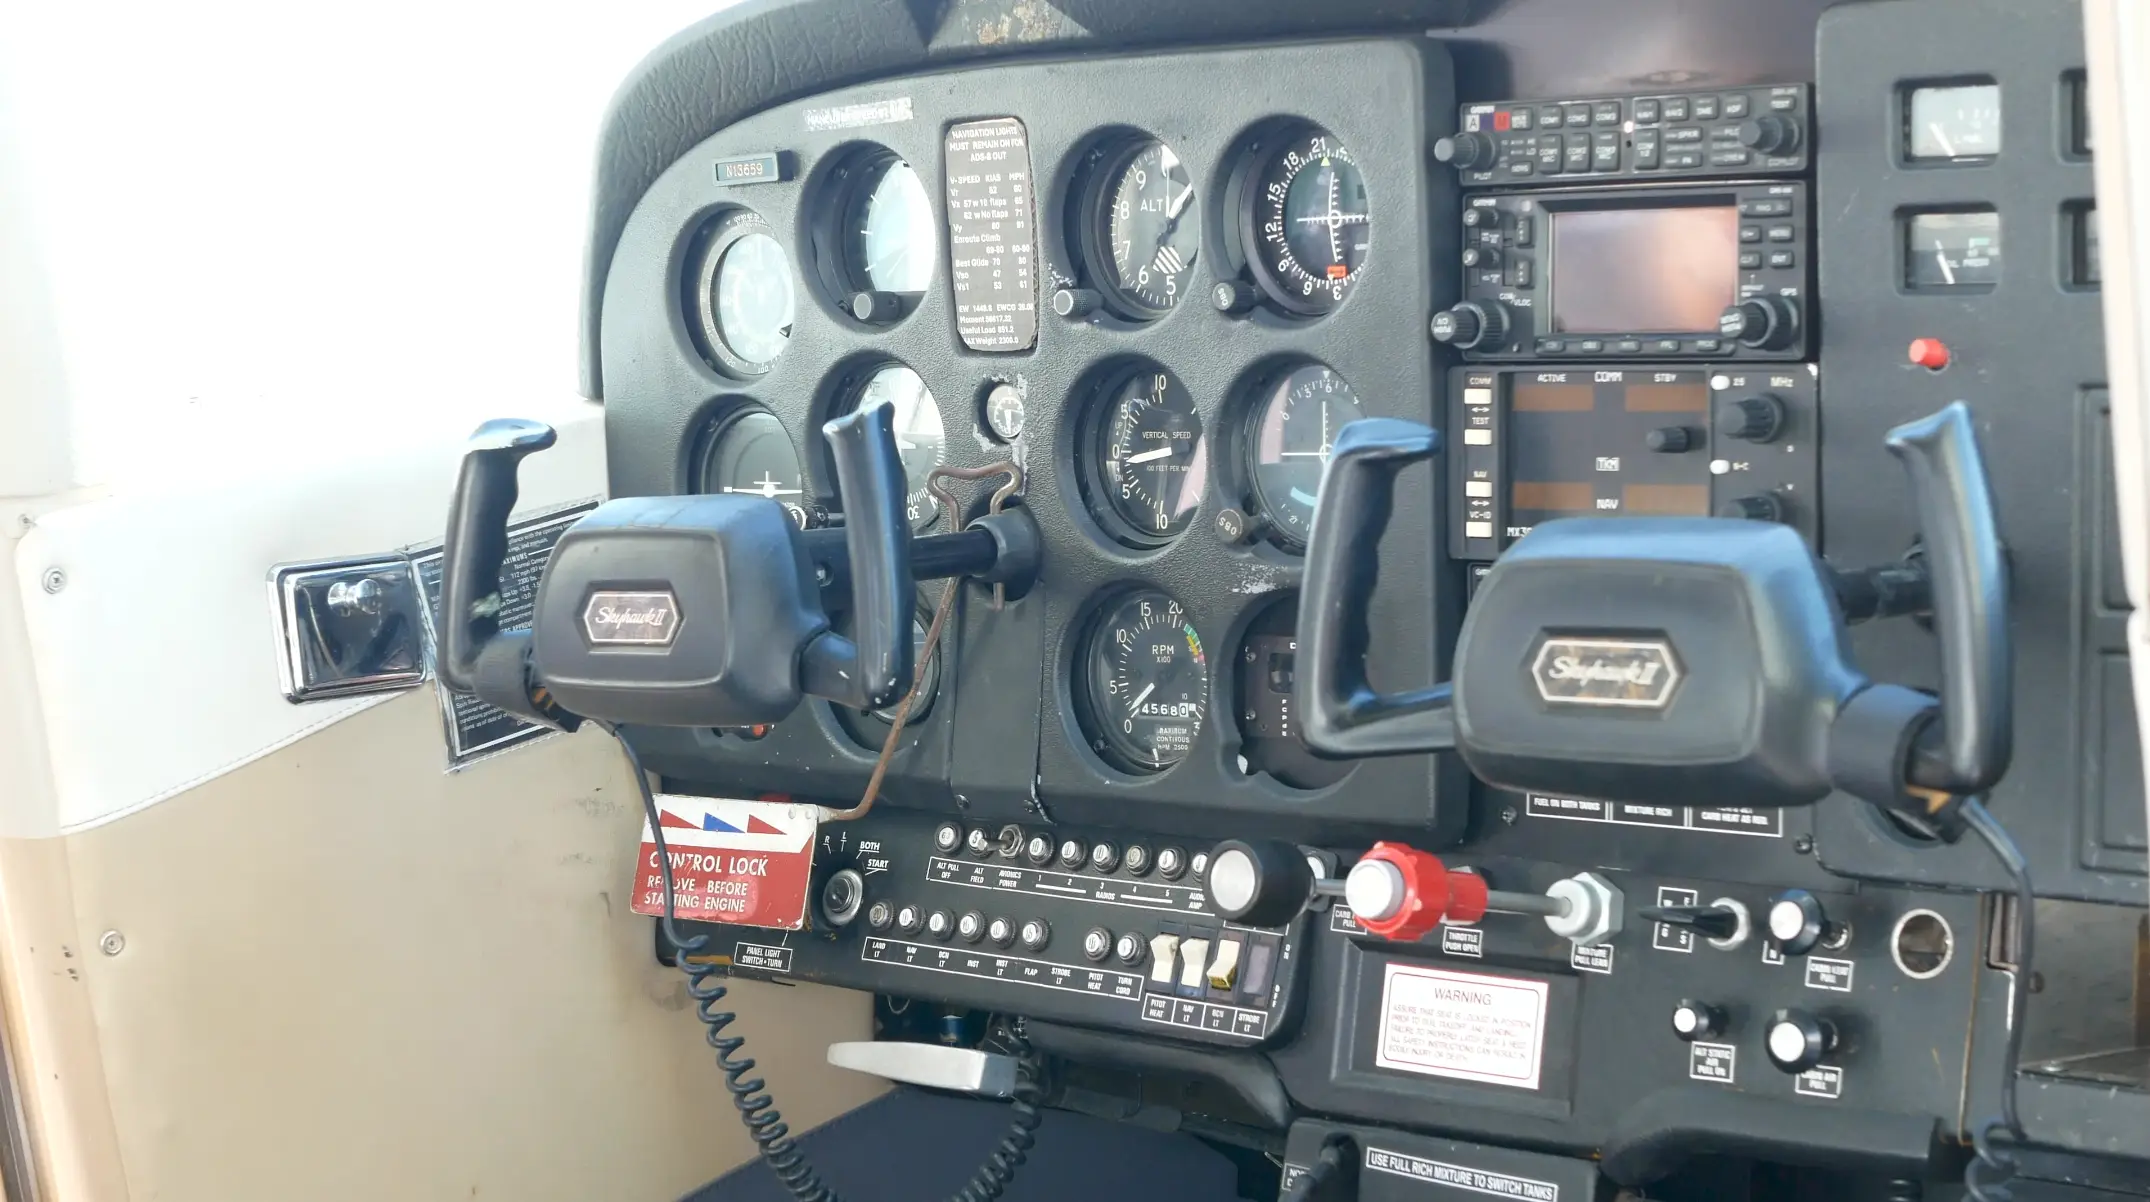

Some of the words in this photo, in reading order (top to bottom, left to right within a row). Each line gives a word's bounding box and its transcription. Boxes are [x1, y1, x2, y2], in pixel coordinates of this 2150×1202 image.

[952, 127, 995, 139] NAVIGATION
[949, 142, 969, 151] MUST
[973, 139, 999, 150] REMAIN
[1000, 139, 1010, 148] ON
[1311, 137, 1326, 153] 21
[993, 151, 1007, 160] OUT
[1283, 152, 1300, 170] 18
[726, 163, 763, 177] N13659
[985, 174, 1001, 182] KIAS
[1009, 172, 1024, 181] MPH
[1135, 171, 1147, 190] 9
[1267, 183, 1281, 201] 15
[1120, 202, 1130, 219] 8
[1140, 200, 1163, 212] ALT
[1266, 222, 1279, 241] 12
[954, 235, 980, 243] Enroute
[981, 234, 1001, 242] Climb
[1122, 240, 1131, 260] 7
[971, 258, 989, 267] Glide
[993, 269, 1001, 277] 47
[1138, 265, 1149, 284] 6
[1166, 276, 1176, 295] 5
[1332, 287, 1342, 300] 3
[959, 305, 969, 313] EW
[960, 315, 985, 323] Moment
[960, 326, 980, 334] Useful
[981, 326, 996, 334] Load
[976, 337, 997, 346] Weight
[1155, 375, 1166, 390] 10
[1537, 374, 1567, 383] ACTIVE
[1594, 372, 1622, 383] COMM
[1654, 373, 1677, 383] STBY
[1770, 376, 1794, 387] MHz
[1121, 404, 1129, 419] 5
[1472, 417, 1490, 425] TEST
[1142, 431, 1168, 439] VERTICAL
[1172, 431, 1191, 439] SPEED
[1112, 445, 1120, 459] 0
[1473, 471, 1487, 479] NAV
[1122, 484, 1130, 499] 5
[1597, 499, 1618, 510] NAV
[1156, 514, 1168, 530] 10
[1219, 518, 1237, 535] OBS
[1140, 602, 1151, 617] 15
[1169, 601, 1183, 614] 20
[595, 607, 654, 629] Skyhawk
[1116, 629, 1127, 644] 10
[1152, 645, 1174, 655] RPM
[1109, 680, 1117, 695] 5
[1124, 719, 1132, 733] 0
[860, 841, 880, 851] BOTH
[729, 856, 768, 876] LOCK
[867, 859, 888, 868] START
[937, 862, 947, 870] ALT
[948, 863, 959, 871] PULL
[999, 870, 1021, 879] AVIONICS
[974, 867, 984, 875] ALT
[970, 875, 984, 883] FIELD
[999, 879, 1017, 887] POWER
[1067, 878, 1073, 886] 2
[707, 880, 748, 896] BEFORE
[1096, 890, 1115, 900] RADIOS
[644, 892, 699, 908] STATING
[705, 897, 745, 912] ENGINE
[1188, 901, 1203, 910] AMP
[1335, 910, 1350, 920] CARB
[1448, 932, 1478, 943] THROTTLE
[746, 947, 762, 957] PANEL
[764, 948, 780, 958] LIGHT
[1446, 941, 1461, 951] PUSH
[1462, 943, 1479, 953] OPEN
[967, 960, 979, 968] INST
[1575, 955, 1589, 965] PULL
[1024, 967, 1038, 976] FLAP
[1051, 967, 1071, 977] STROBE
[1056, 977, 1063, 985] LT
[1088, 972, 1104, 981] PITOT
[1118, 976, 1132, 985] TURN
[1087, 982, 1102, 990] HEAT
[1434, 988, 1492, 1006] WARNING
[1151, 999, 1166, 1009] PITOT
[1182, 1004, 1194, 1012] NAV
[1149, 1008, 1164, 1018] HEAT
[1183, 1014, 1190, 1022] LT
[1238, 1013, 1260, 1024] STROBE
[1212, 1019, 1220, 1027] LT
[1244, 1024, 1251, 1032] LT
[1371, 1152, 1388, 1166] USE
[1389, 1155, 1410, 1172] FULL
[1412, 1160, 1433, 1176] RICH
[1434, 1164, 1472, 1184] MIXTURE
[1473, 1172, 1485, 1187] TO
[1486, 1174, 1521, 1196] SWITCH
[1522, 1182, 1553, 1200] TANKS
